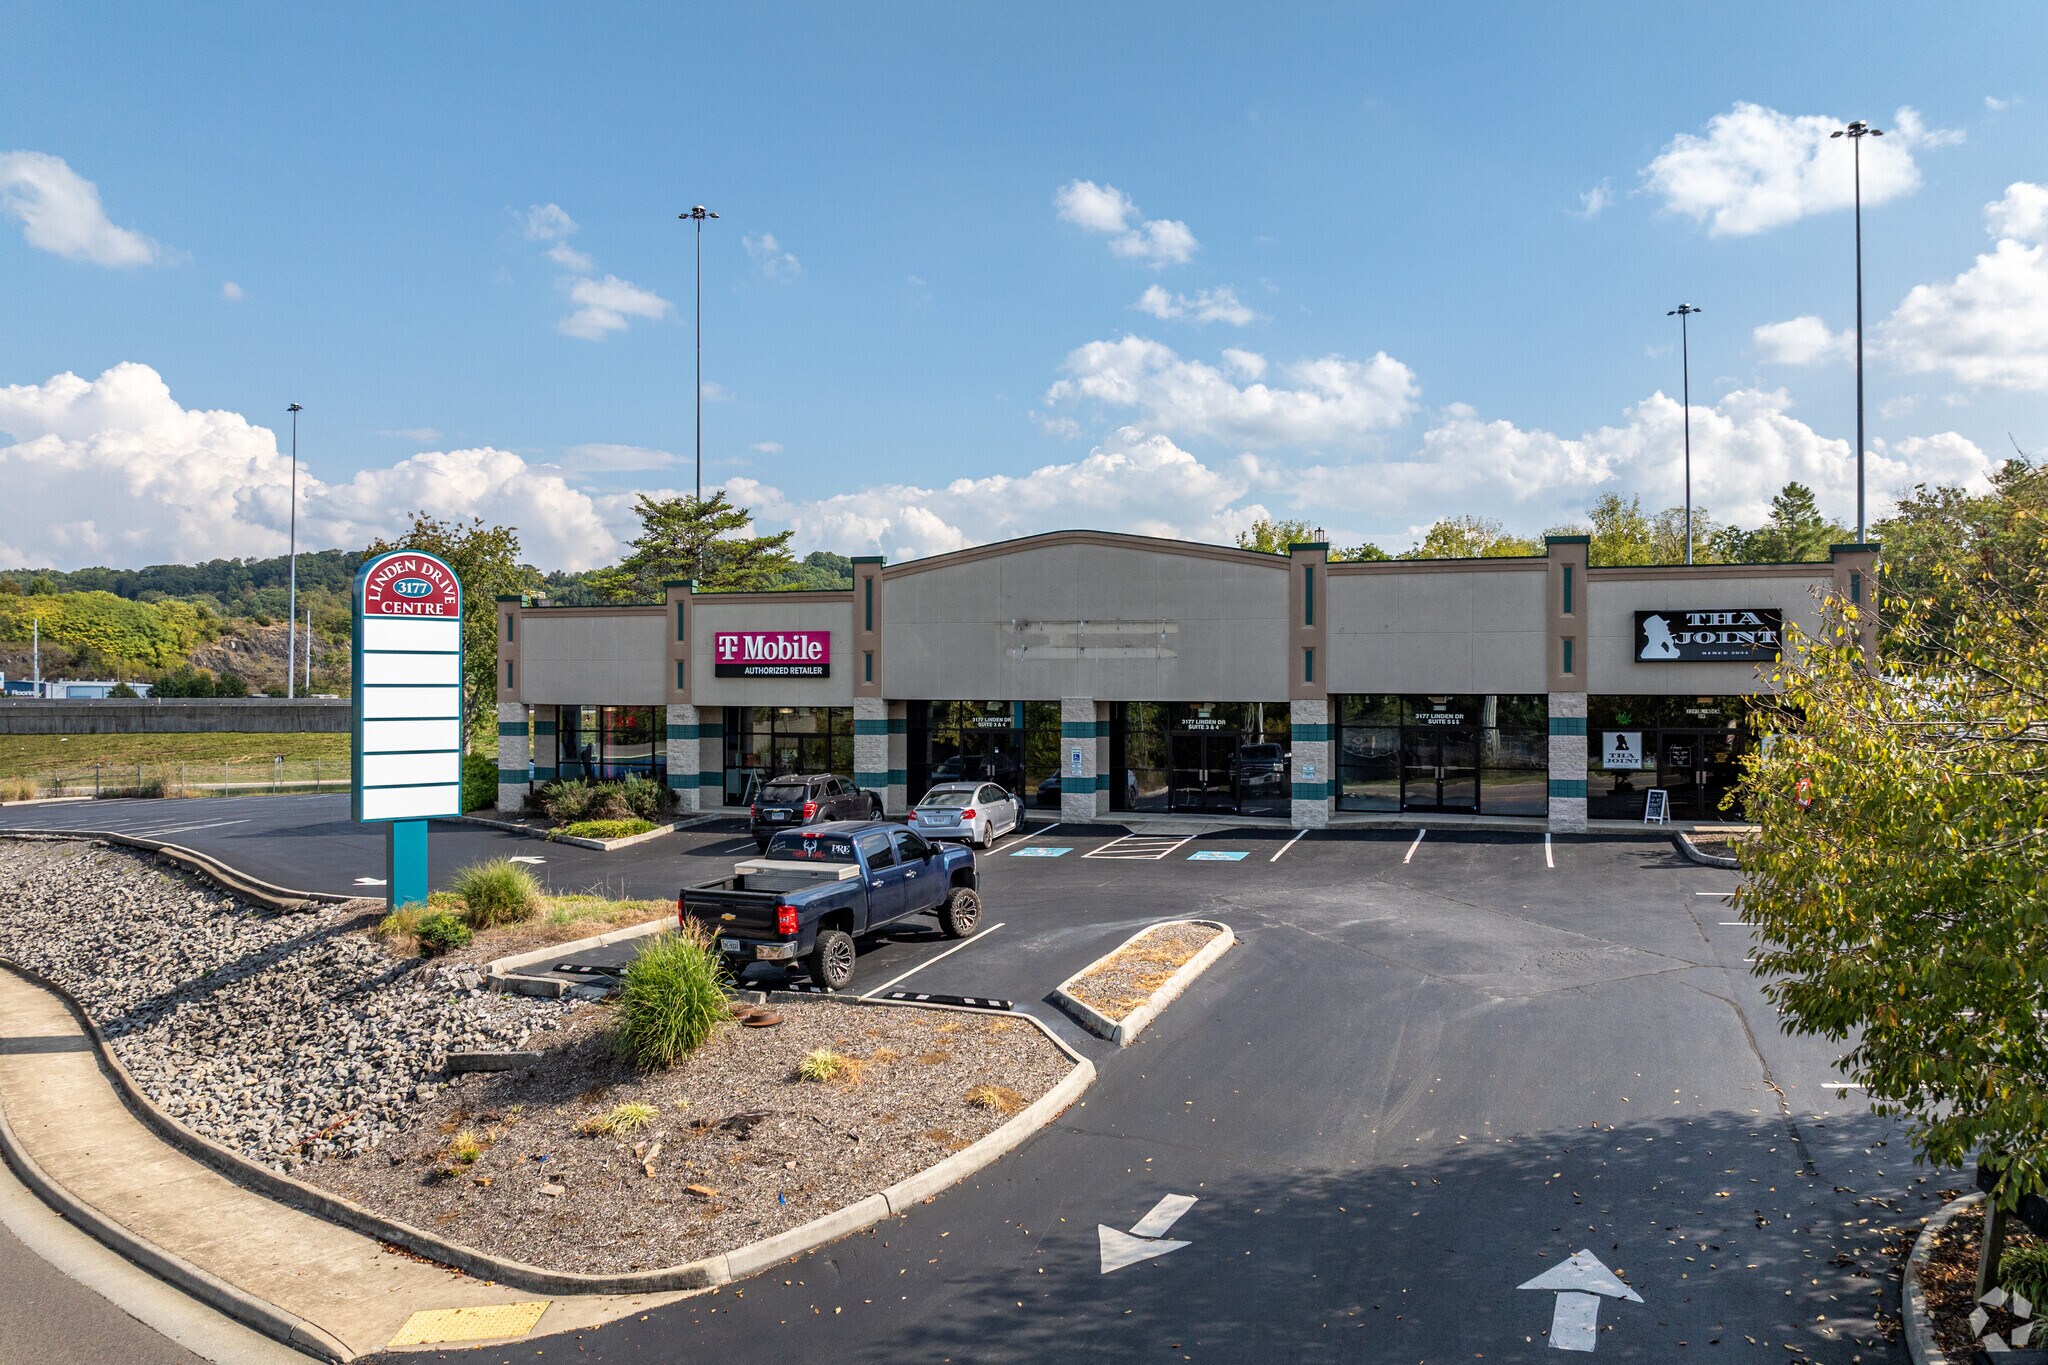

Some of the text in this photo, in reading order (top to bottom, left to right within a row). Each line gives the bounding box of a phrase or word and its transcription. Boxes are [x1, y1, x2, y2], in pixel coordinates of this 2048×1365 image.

[369, 560, 456, 604] LINDEN DRIVE
[398, 582, 428, 593] 3177
[381, 601, 444, 615] CENTRE
[1686, 612, 1764, 626] THA
[1675, 631, 1777, 644] JOINT
[743, 635, 823, 660] Mobile
[744, 667, 823, 675] AUTHORIZED RETAILER
[831, 844, 850, 854] PRE
